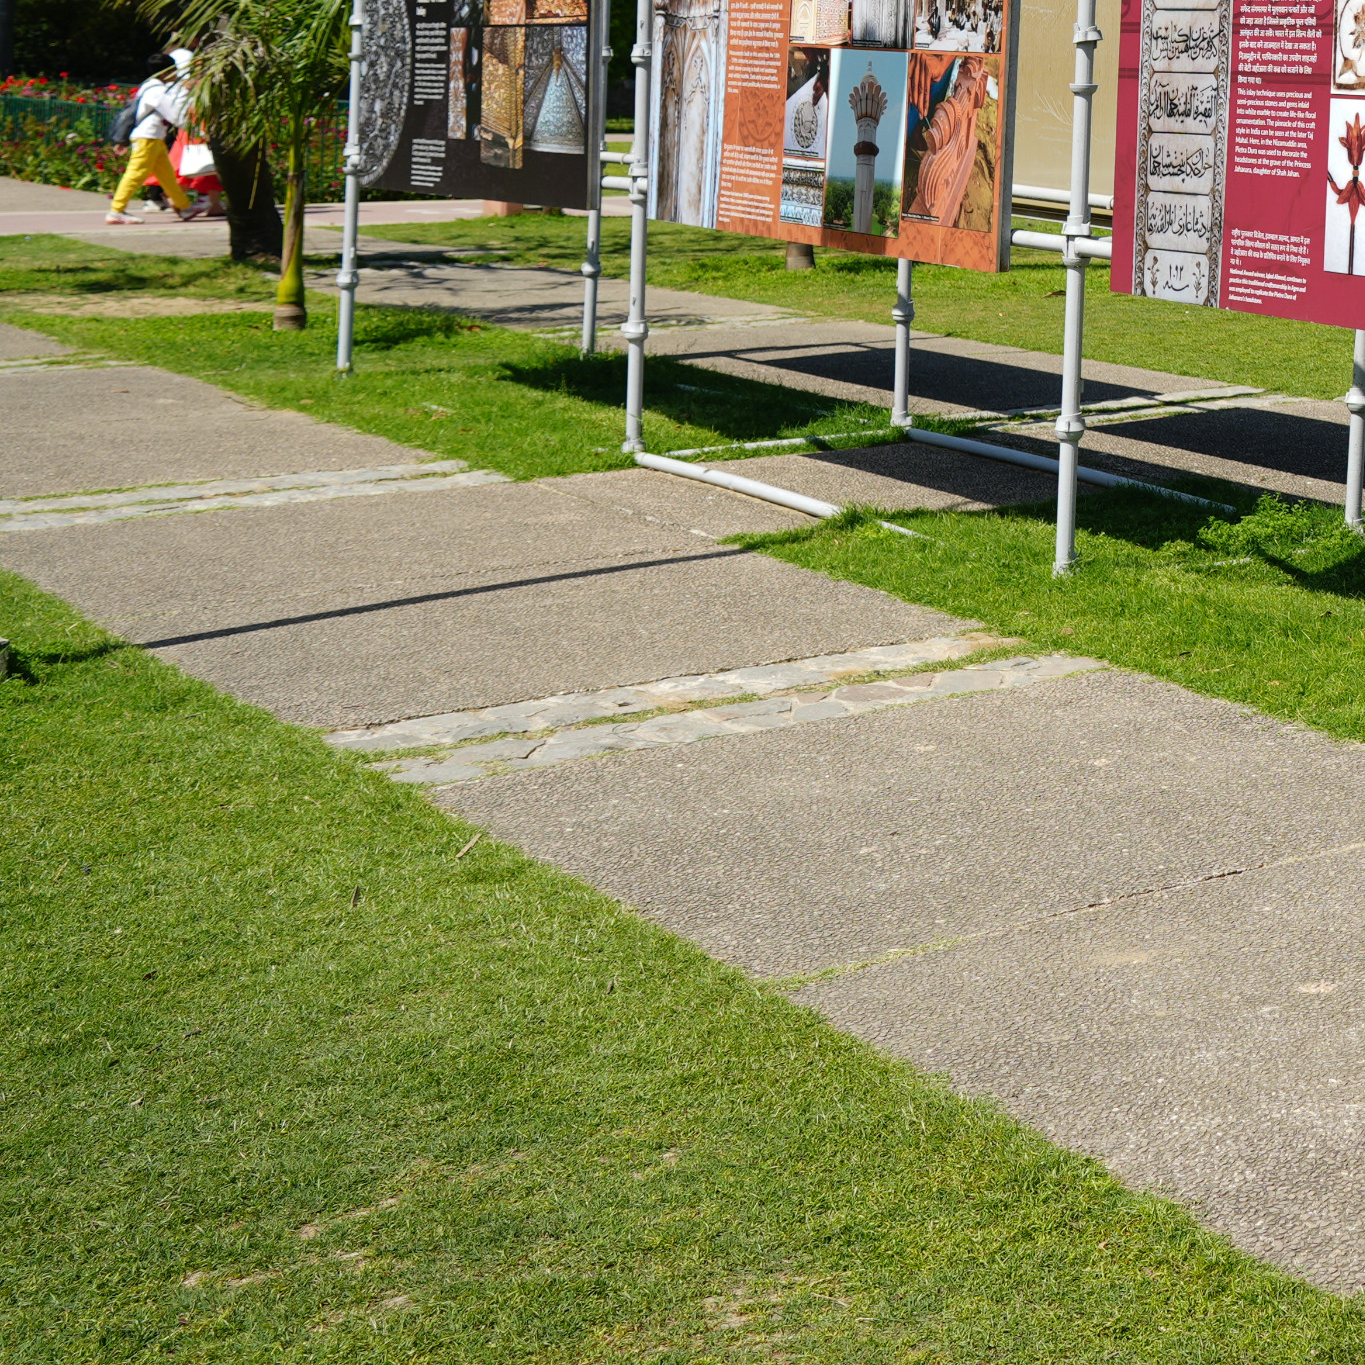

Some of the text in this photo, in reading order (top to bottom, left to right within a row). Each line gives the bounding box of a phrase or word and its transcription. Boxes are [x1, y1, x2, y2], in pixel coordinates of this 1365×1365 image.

[1246, 89, 1255, 97] inlay
[1256, 90, 1275, 98] technique
[1286, 91, 1303, 99] precious
[1237, 98, 1264, 106] semi-precious
